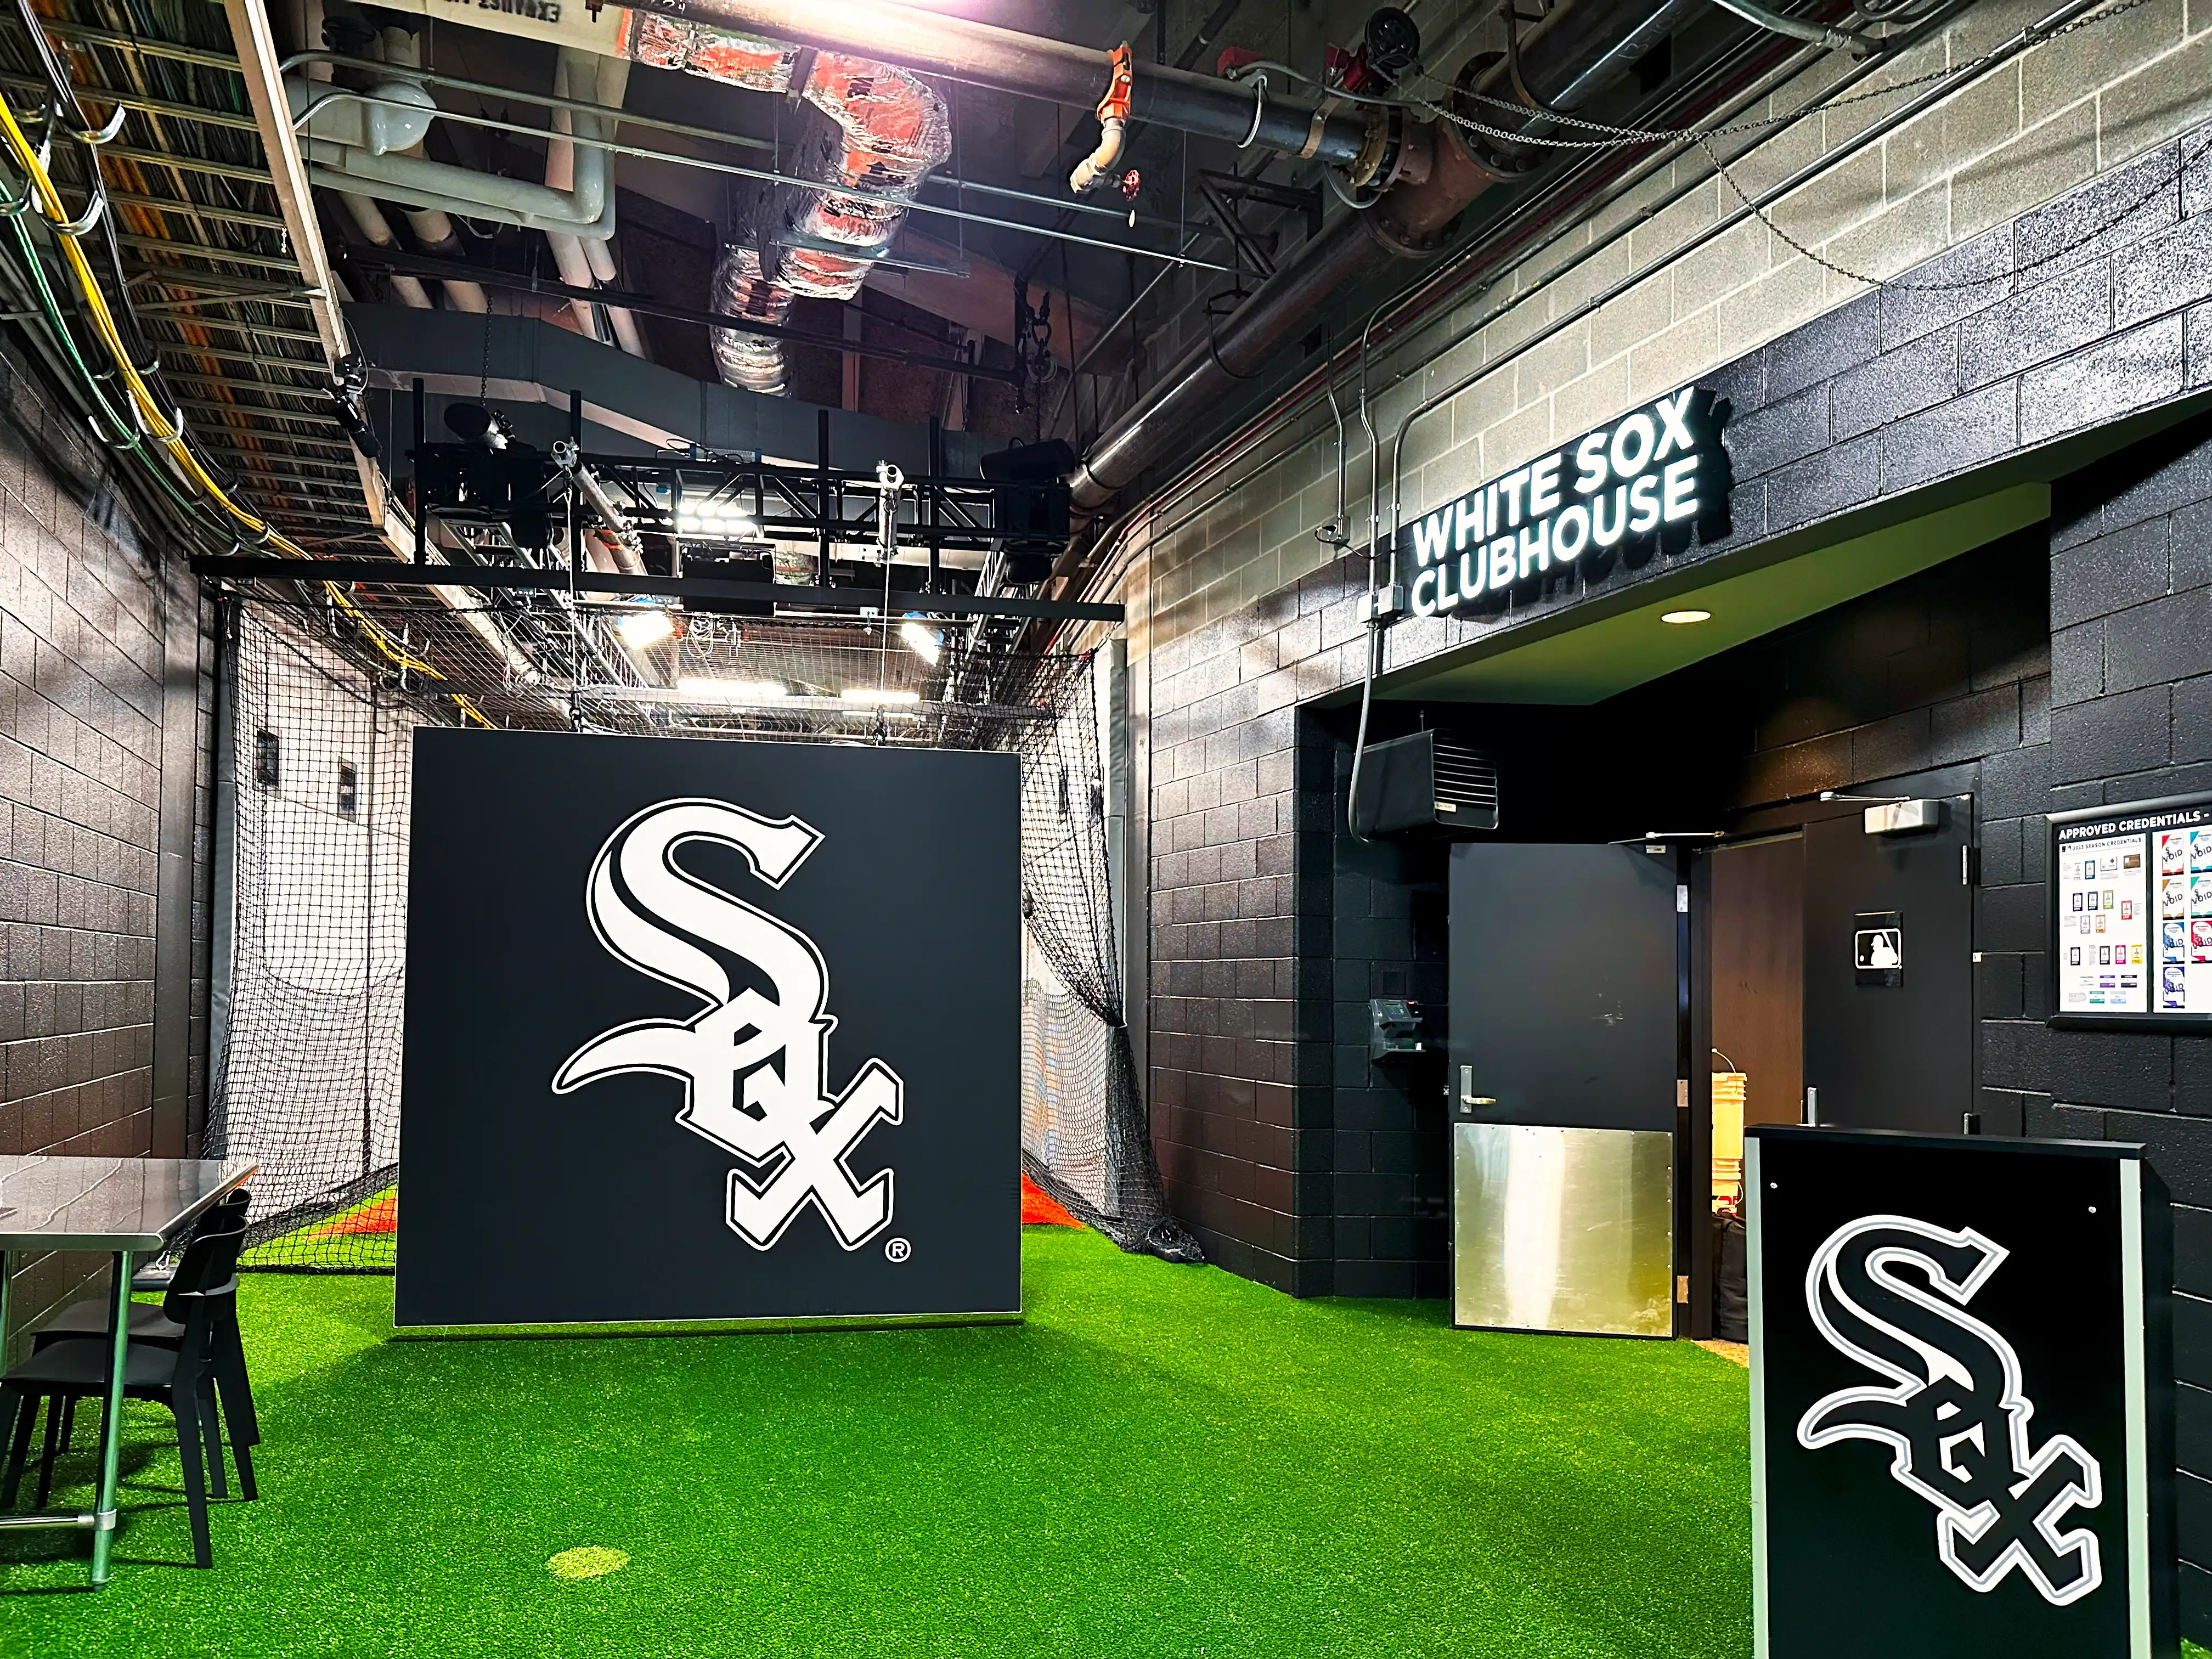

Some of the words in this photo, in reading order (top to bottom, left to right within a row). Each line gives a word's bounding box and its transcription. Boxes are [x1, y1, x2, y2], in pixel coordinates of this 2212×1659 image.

[1412, 452, 1561, 566] WHITE
[1575, 386, 1695, 493] SOX
[1411, 455, 1699, 617] CLUBHOUSE
[2058, 823, 2116, 840] APPROVED
[2119, 810, 2201, 833] CREDENTIALS
[2107, 837, 2142, 847] CREDENTIALS
